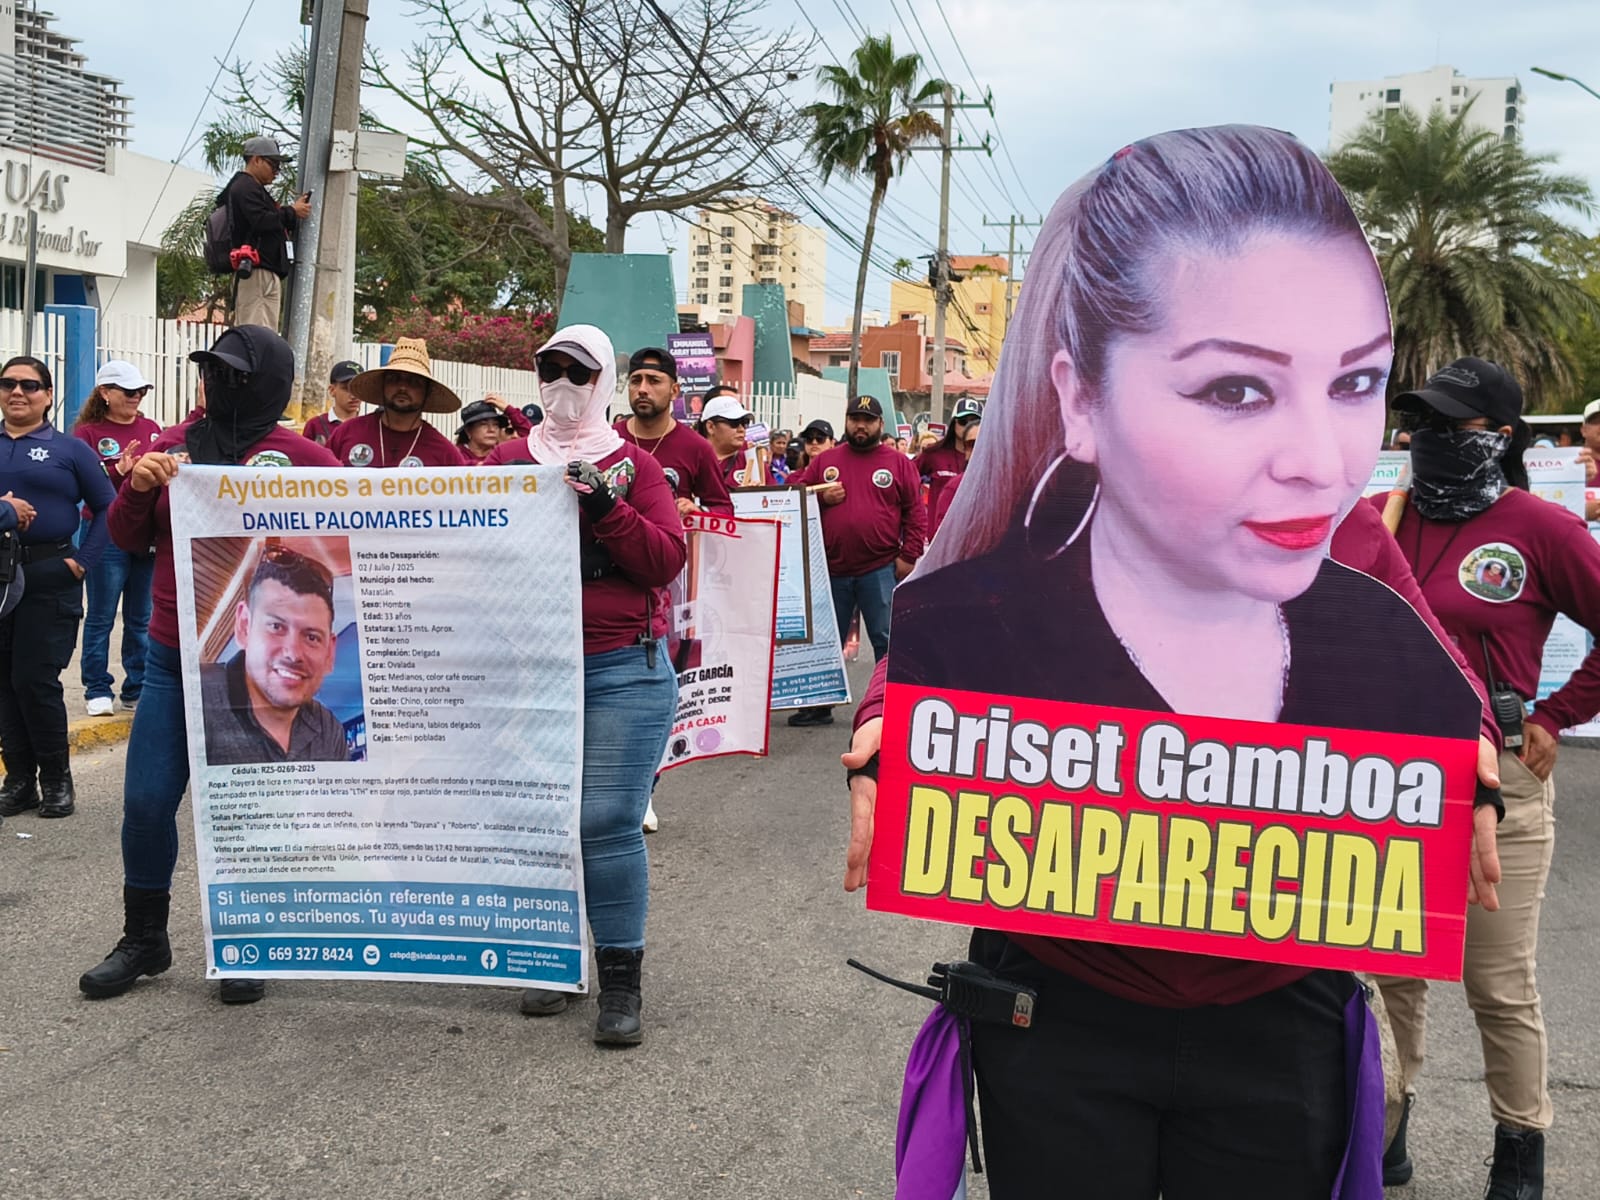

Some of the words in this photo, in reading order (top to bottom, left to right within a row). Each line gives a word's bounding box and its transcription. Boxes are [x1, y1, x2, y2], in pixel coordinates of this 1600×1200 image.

[5, 159, 70, 213] UAS
[9, 215, 74, 254] Rional
[76, 230, 103, 257] Sur
[217, 474, 349, 505] Ayúdanos
[358, 478, 373, 497] a
[381, 472, 514, 497] encontrar
[522, 474, 538, 494] a
[243, 512, 310, 530] DANIEL
[316, 510, 433, 529] PALOMARES
[439, 508, 509, 528] LLANES
[357, 551, 378, 559] Fecha
[379, 551, 389, 559] de
[390, 550, 440, 560] Desaparición:
[359, 576, 396, 585] Municipio
[363, 612, 383, 620] Edad:
[395, 612, 412, 620] años
[431, 625, 455, 634] Aprox.
[366, 649, 410, 658] Complexión:
[412, 649, 440, 659] Delgada
[368, 673, 386, 683] Ojos:
[388, 673, 425, 682] Medianos,
[426, 673, 444, 681] color
[445, 672, 460, 681] café
[699, 664, 734, 682] GARCÍA
[370, 697, 399, 705] Cabello:
[400, 697, 423, 706] Chino,
[424, 697, 442, 705] color
[444, 698, 465, 706] negro
[708, 695, 732, 704] DESDE
[398, 709, 429, 718] Pequeña
[393, 722, 426, 730] Mediana,
[450, 722, 481, 730] delgados
[696, 715, 727, 728] CASA!
[372, 734, 394, 743] Cejas:
[395, 734, 412, 742] Semi
[414, 734, 446, 743] pobladas
[909, 698, 1122, 793] Griset
[1138, 722, 1444, 827] Gamboa
[232, 766, 260, 775] Cédula:
[208, 781, 228, 789] Ropa:
[230, 779, 255, 788] Playera
[317, 777, 333, 785] larga
[385, 777, 409, 786] playera
[209, 791, 247, 800] estampado
[266, 790, 284, 798] parte
[413, 788, 442, 797] pantalón
[220, 802, 237, 810] color
[211, 813, 231, 821] Señas
[233, 812, 275, 820] Particulares:
[277, 811, 294, 819] Lunar
[212, 824, 243, 832] Tatuajes:
[245, 823, 271, 831] Tatuaje
[291, 822, 310, 831] figura
[383, 821, 408, 830] leyenda
[214, 845, 231, 853] Visto
[233, 846, 244, 854] por
[216, 866, 246, 875] paradero
[248, 865, 267, 873] actual
[269, 865, 289, 873] desde
[902, 787, 1425, 954] DESAPARECIDA
[217, 891, 233, 905] Si
[240, 890, 287, 904] tienes
[294, 889, 382, 904] información
[390, 891, 455, 906] referente
[461, 894, 470, 906] a
[477, 893, 507, 908] esta
[513, 896, 573, 916] persona,
[219, 912, 260, 926] llama
[265, 912, 275, 924] o
[279, 909, 365, 924] escribenos.
[368, 909, 386, 924] Tu
[391, 910, 435, 927] ayuda
[438, 914, 455, 927] es
[459, 915, 490, 931] muy
[495, 913, 574, 934] importante.
[268, 947, 292, 961] 669
[296, 947, 318, 961] 327
[322, 947, 353, 962] 8424
